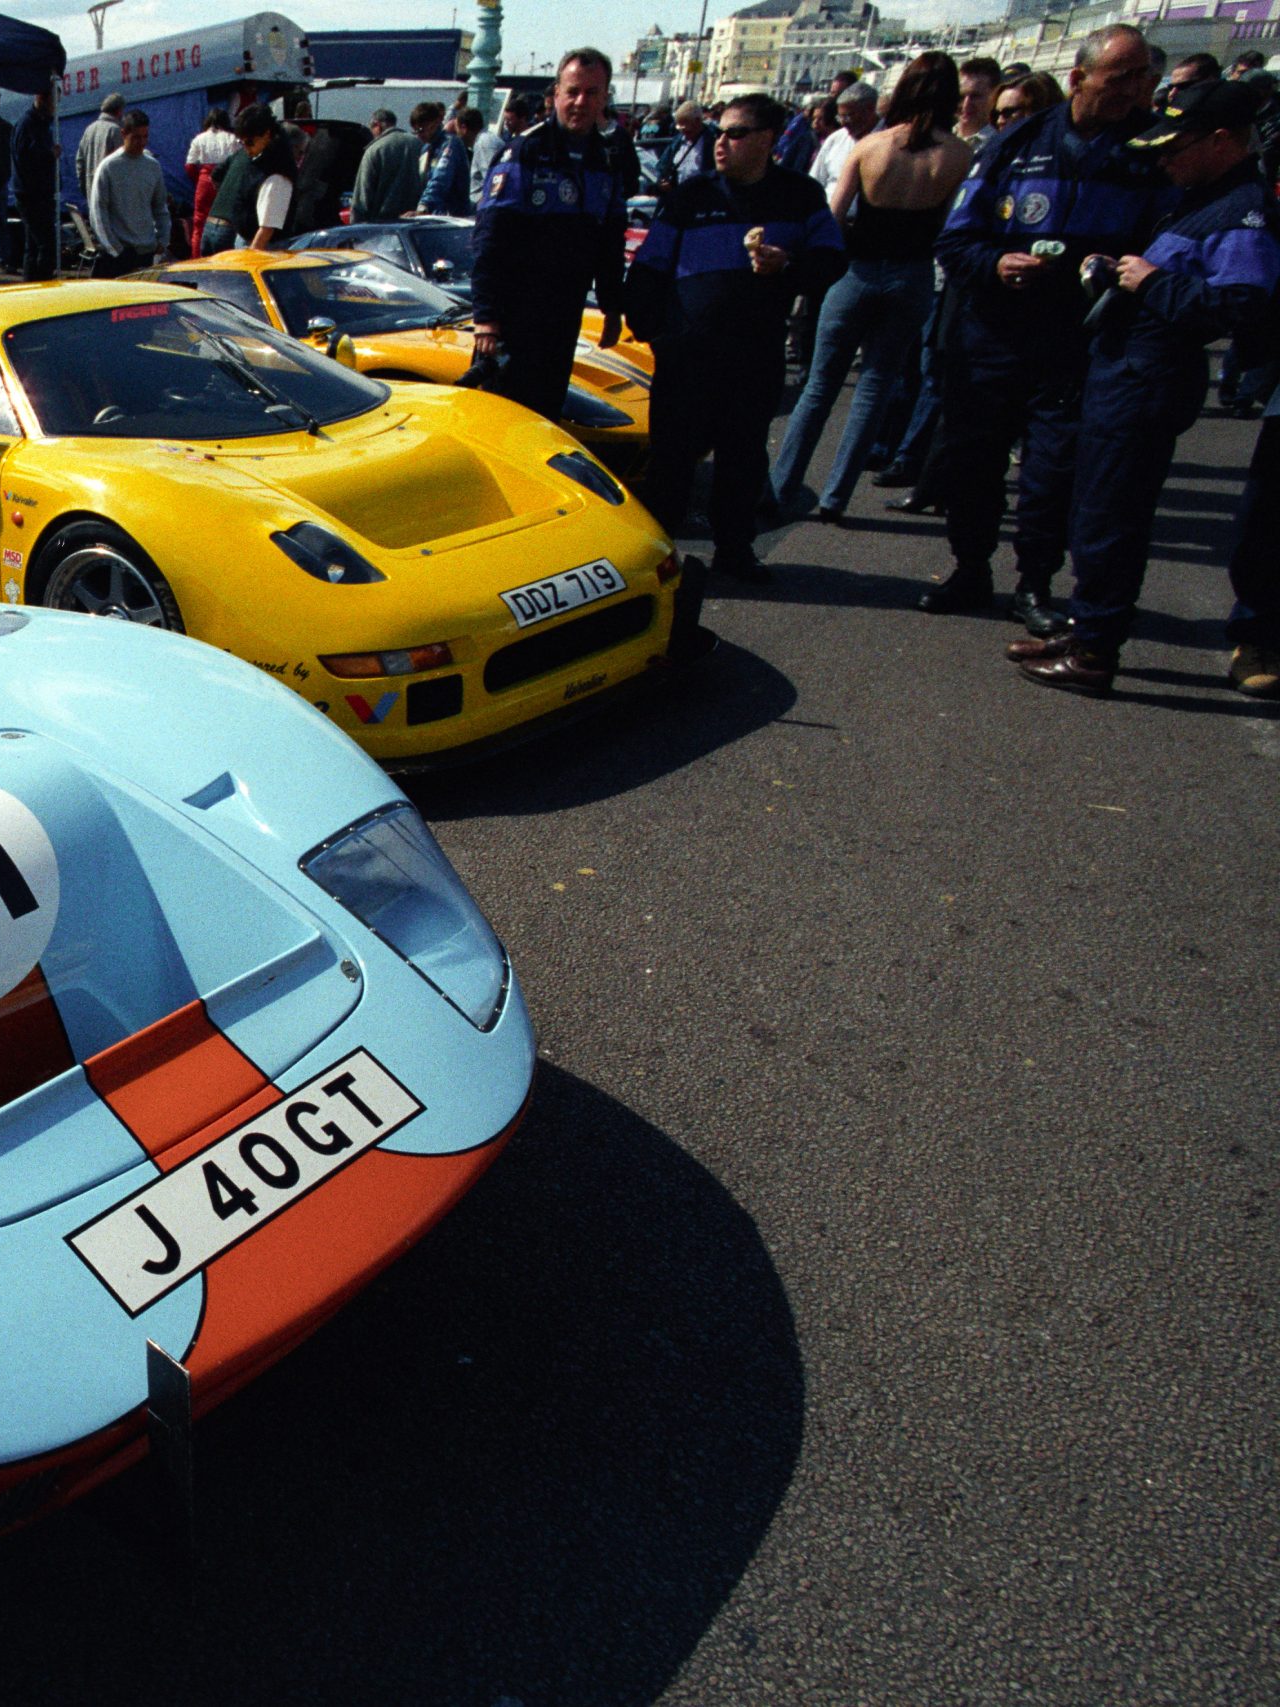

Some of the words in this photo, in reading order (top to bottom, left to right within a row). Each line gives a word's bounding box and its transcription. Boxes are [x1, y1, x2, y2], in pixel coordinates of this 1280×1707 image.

[121, 44, 202, 84] RACING
[510, 581, 569, 621] DDZ
[564, 564, 617, 599] 719
[293, 662, 311, 681] by
[134, 1203, 182, 1275] J
[201, 1071, 384, 1221] 40GT
